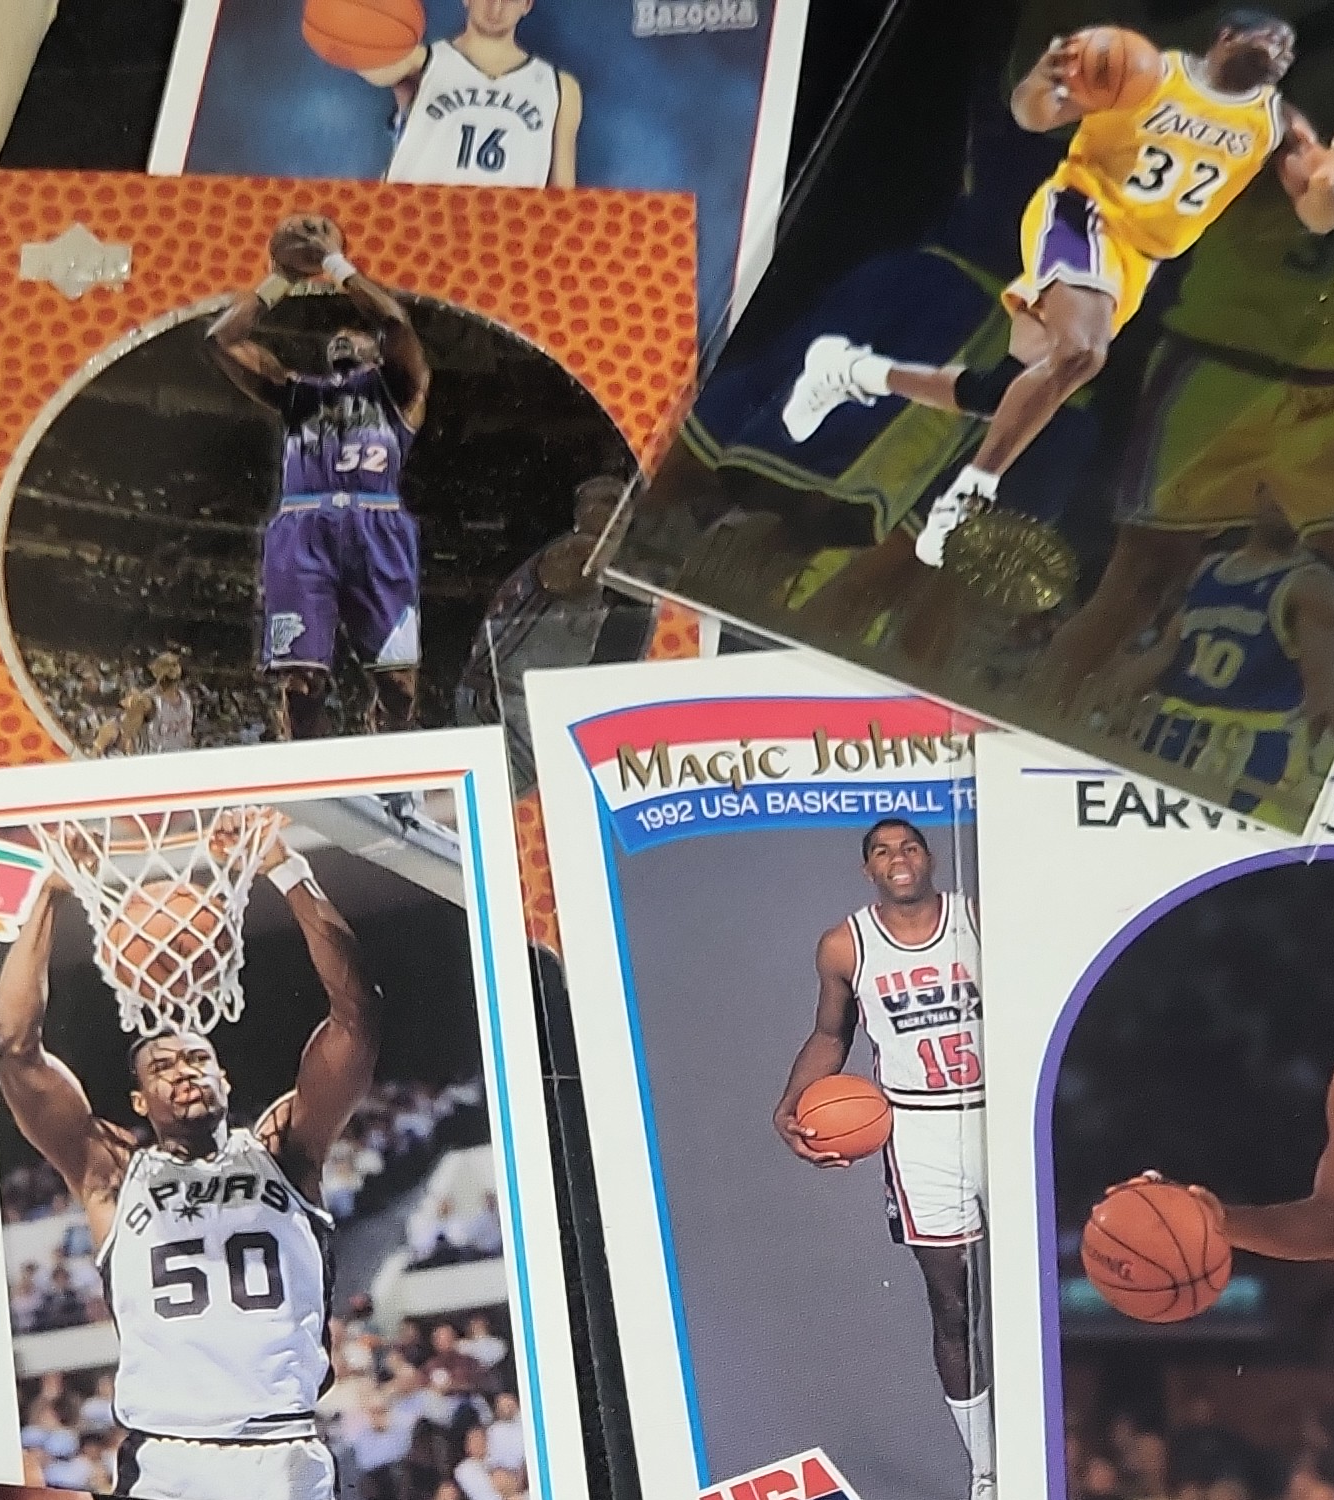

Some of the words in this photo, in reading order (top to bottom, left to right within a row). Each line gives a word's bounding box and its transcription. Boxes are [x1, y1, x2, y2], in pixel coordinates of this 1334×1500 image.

[425, 88, 544, 132] GRIZZLIES
[1142, 103, 1252, 156] LAKERS
[456, 123, 508, 172] 16
[1127, 145, 1220, 208] 32
[334, 443, 389, 474] 32
[811, 719, 976, 777] Johns
[636, 800, 695, 833] 1992
[700, 794, 760, 819] USA
[767, 790, 944, 815] BASKETBALL
[875, 962, 981, 1013] USA
[916, 1031, 982, 1089] 15
[125, 1174, 289, 1236] SPURS
[151, 1231, 286, 1319] 50
